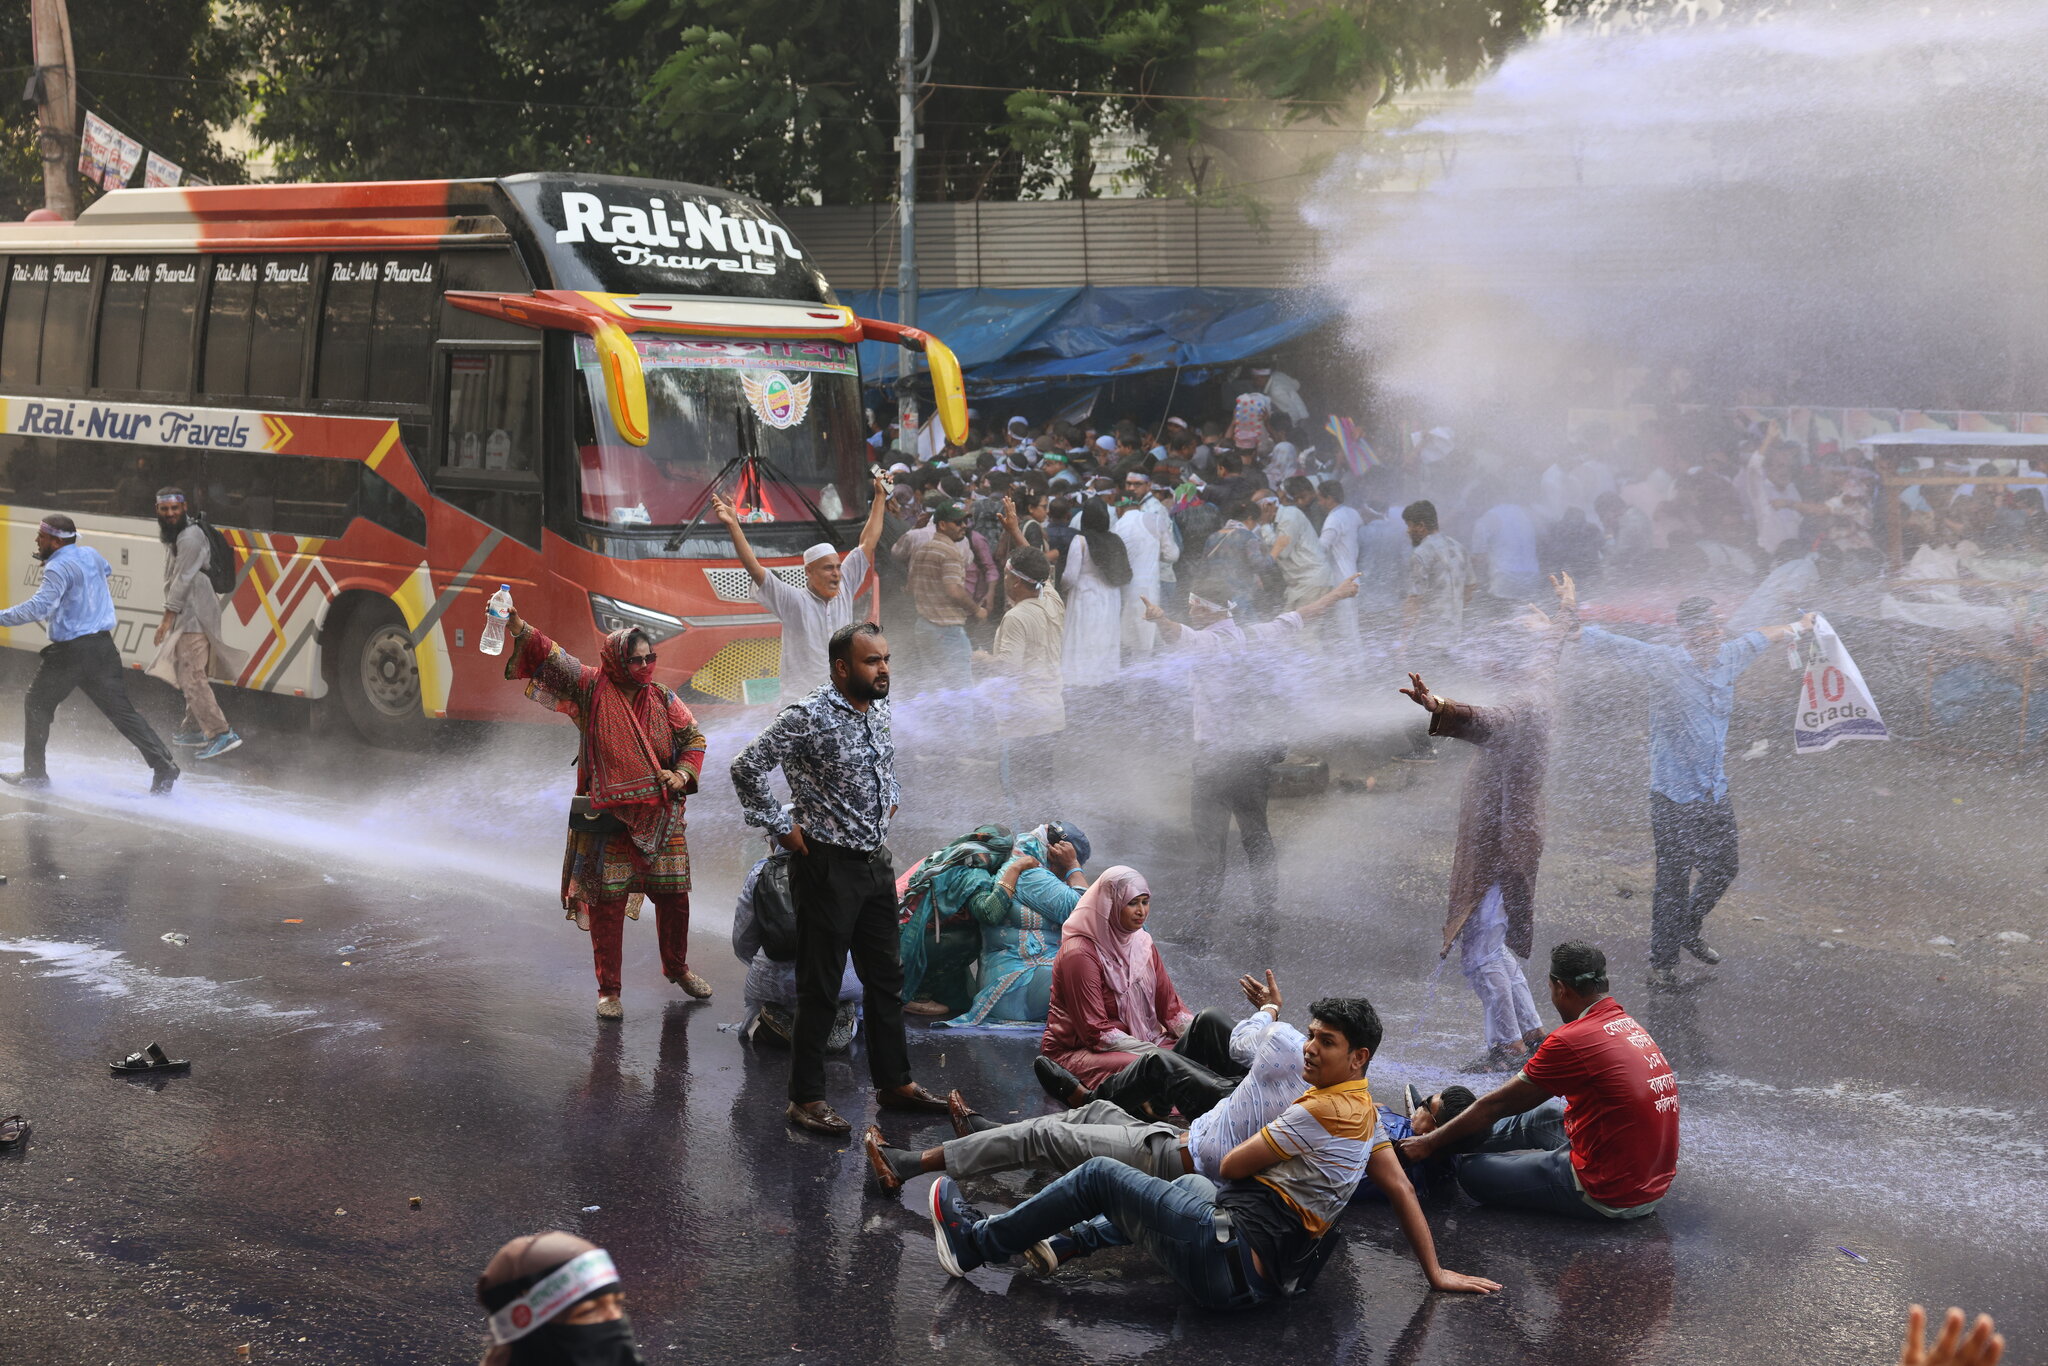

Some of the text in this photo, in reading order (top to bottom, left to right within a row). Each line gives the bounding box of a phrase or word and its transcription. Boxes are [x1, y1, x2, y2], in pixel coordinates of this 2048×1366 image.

[556, 192, 802, 260] Rai-Nur
[52, 264, 90, 283] Travels
[154, 263, 196, 283] Travels
[264, 262, 309, 282] Travels
[383, 261, 432, 282] Travels
[612, 246, 776, 275] Travels
[160, 411, 250, 449] Travels
[1802, 665, 1845, 709] 10
[1803, 702, 1868, 728] Grade
